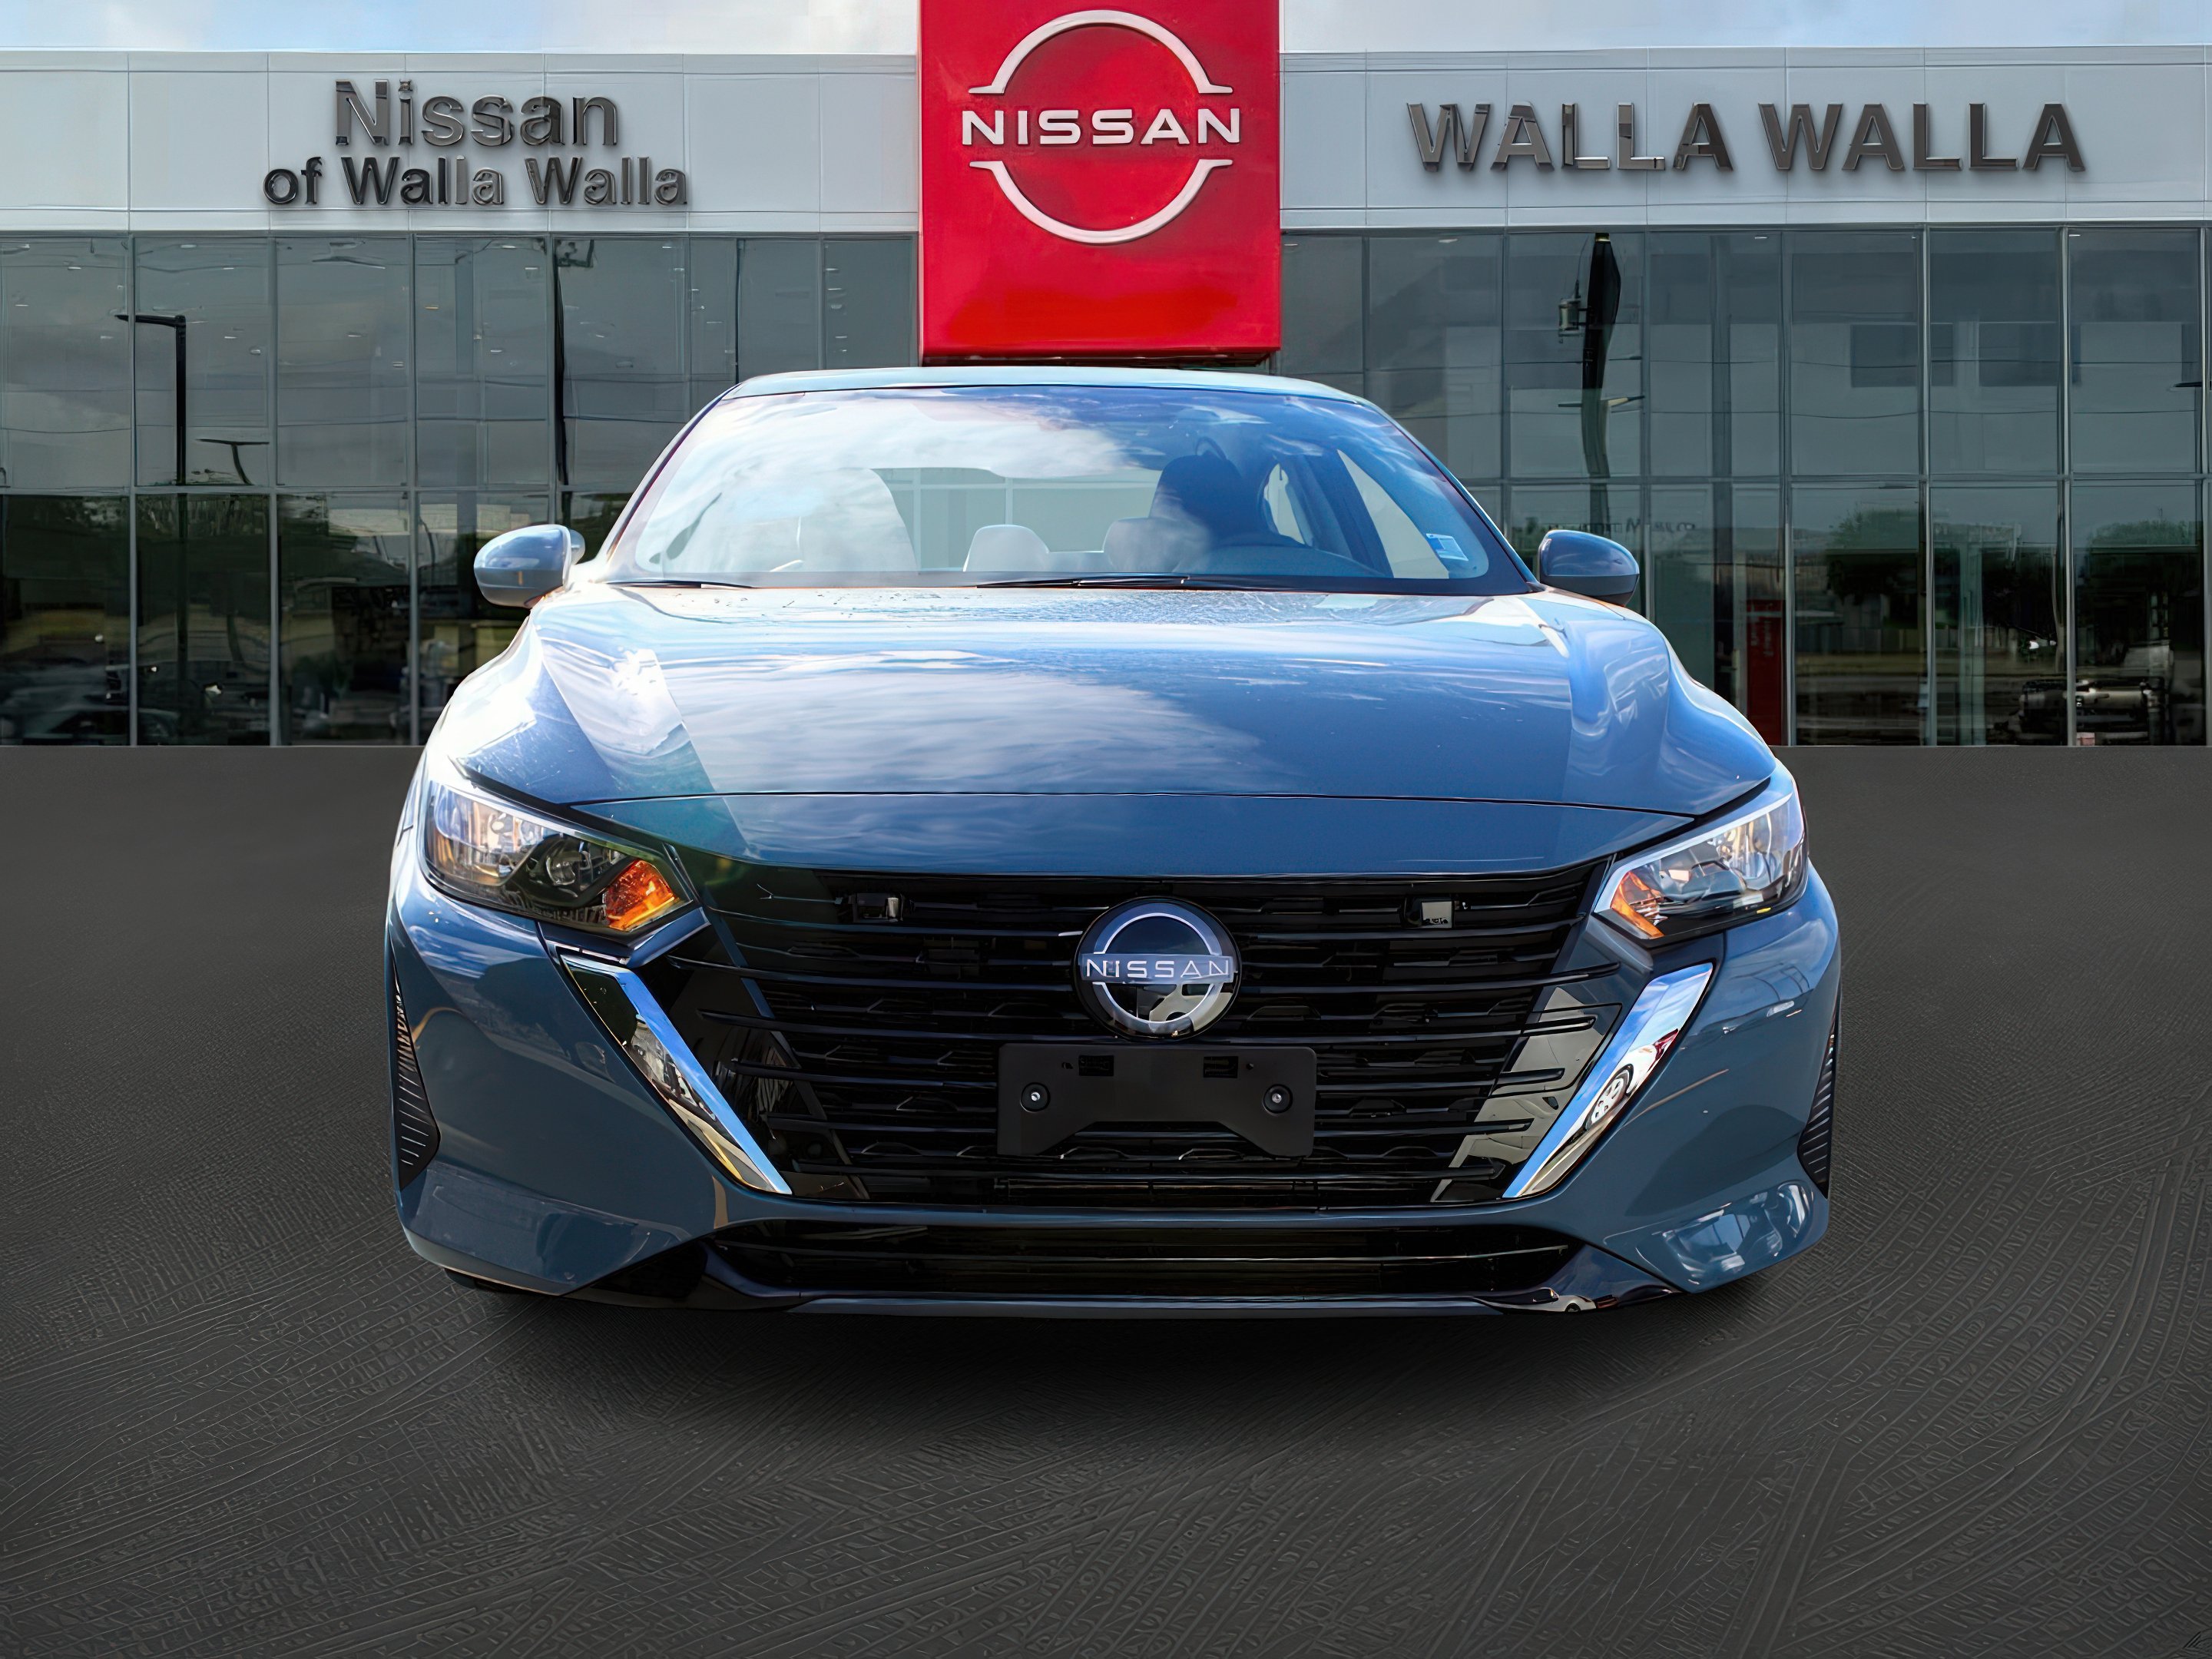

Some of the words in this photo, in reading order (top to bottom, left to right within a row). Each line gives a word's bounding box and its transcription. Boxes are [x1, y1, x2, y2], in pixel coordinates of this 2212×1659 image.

[335, 78, 618, 147] Nissan
[962, 108, 1240, 144] NISSAN
[1406, 101, 1734, 171] WALLA
[1758, 102, 2086, 171] WALLA
[263, 156, 323, 205] of
[340, 156, 505, 205] Walla
[525, 156, 687, 205] Walla
[1086, 959, 1230, 979] NISSAN
